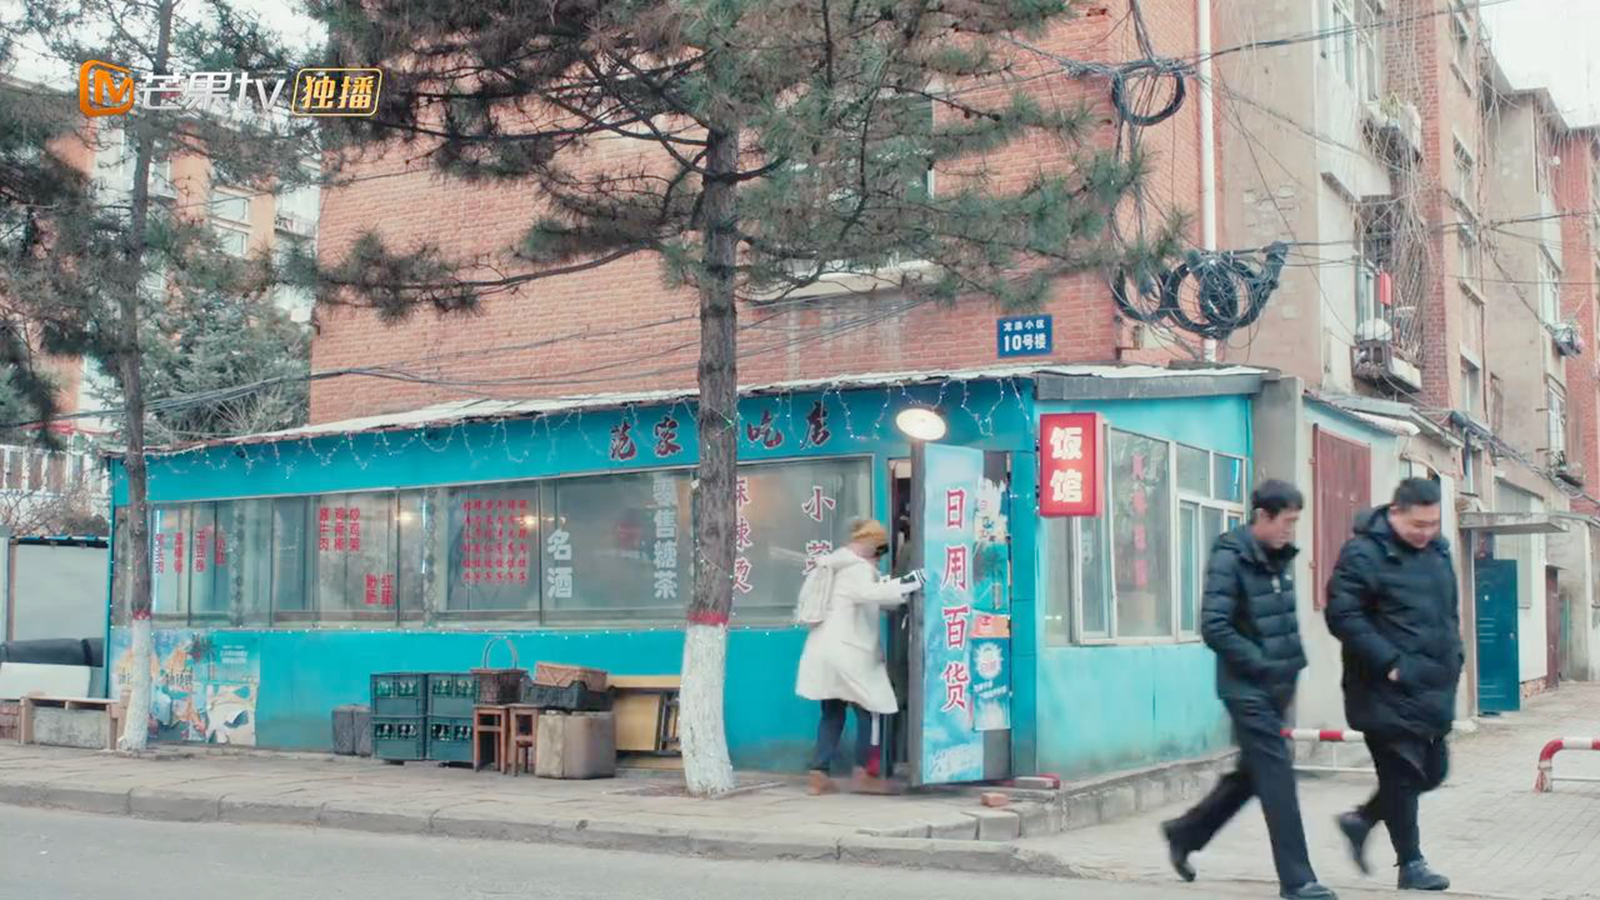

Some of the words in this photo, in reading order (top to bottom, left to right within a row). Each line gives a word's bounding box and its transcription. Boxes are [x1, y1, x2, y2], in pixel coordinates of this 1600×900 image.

[1004, 332, 1047, 353] 10号楼
[610, 400, 831, 460] 范家吃店
[1050, 426, 1083, 503] 饭馆
[547, 528, 573, 599] 名酒
[940, 487, 971, 713] 日用百货
